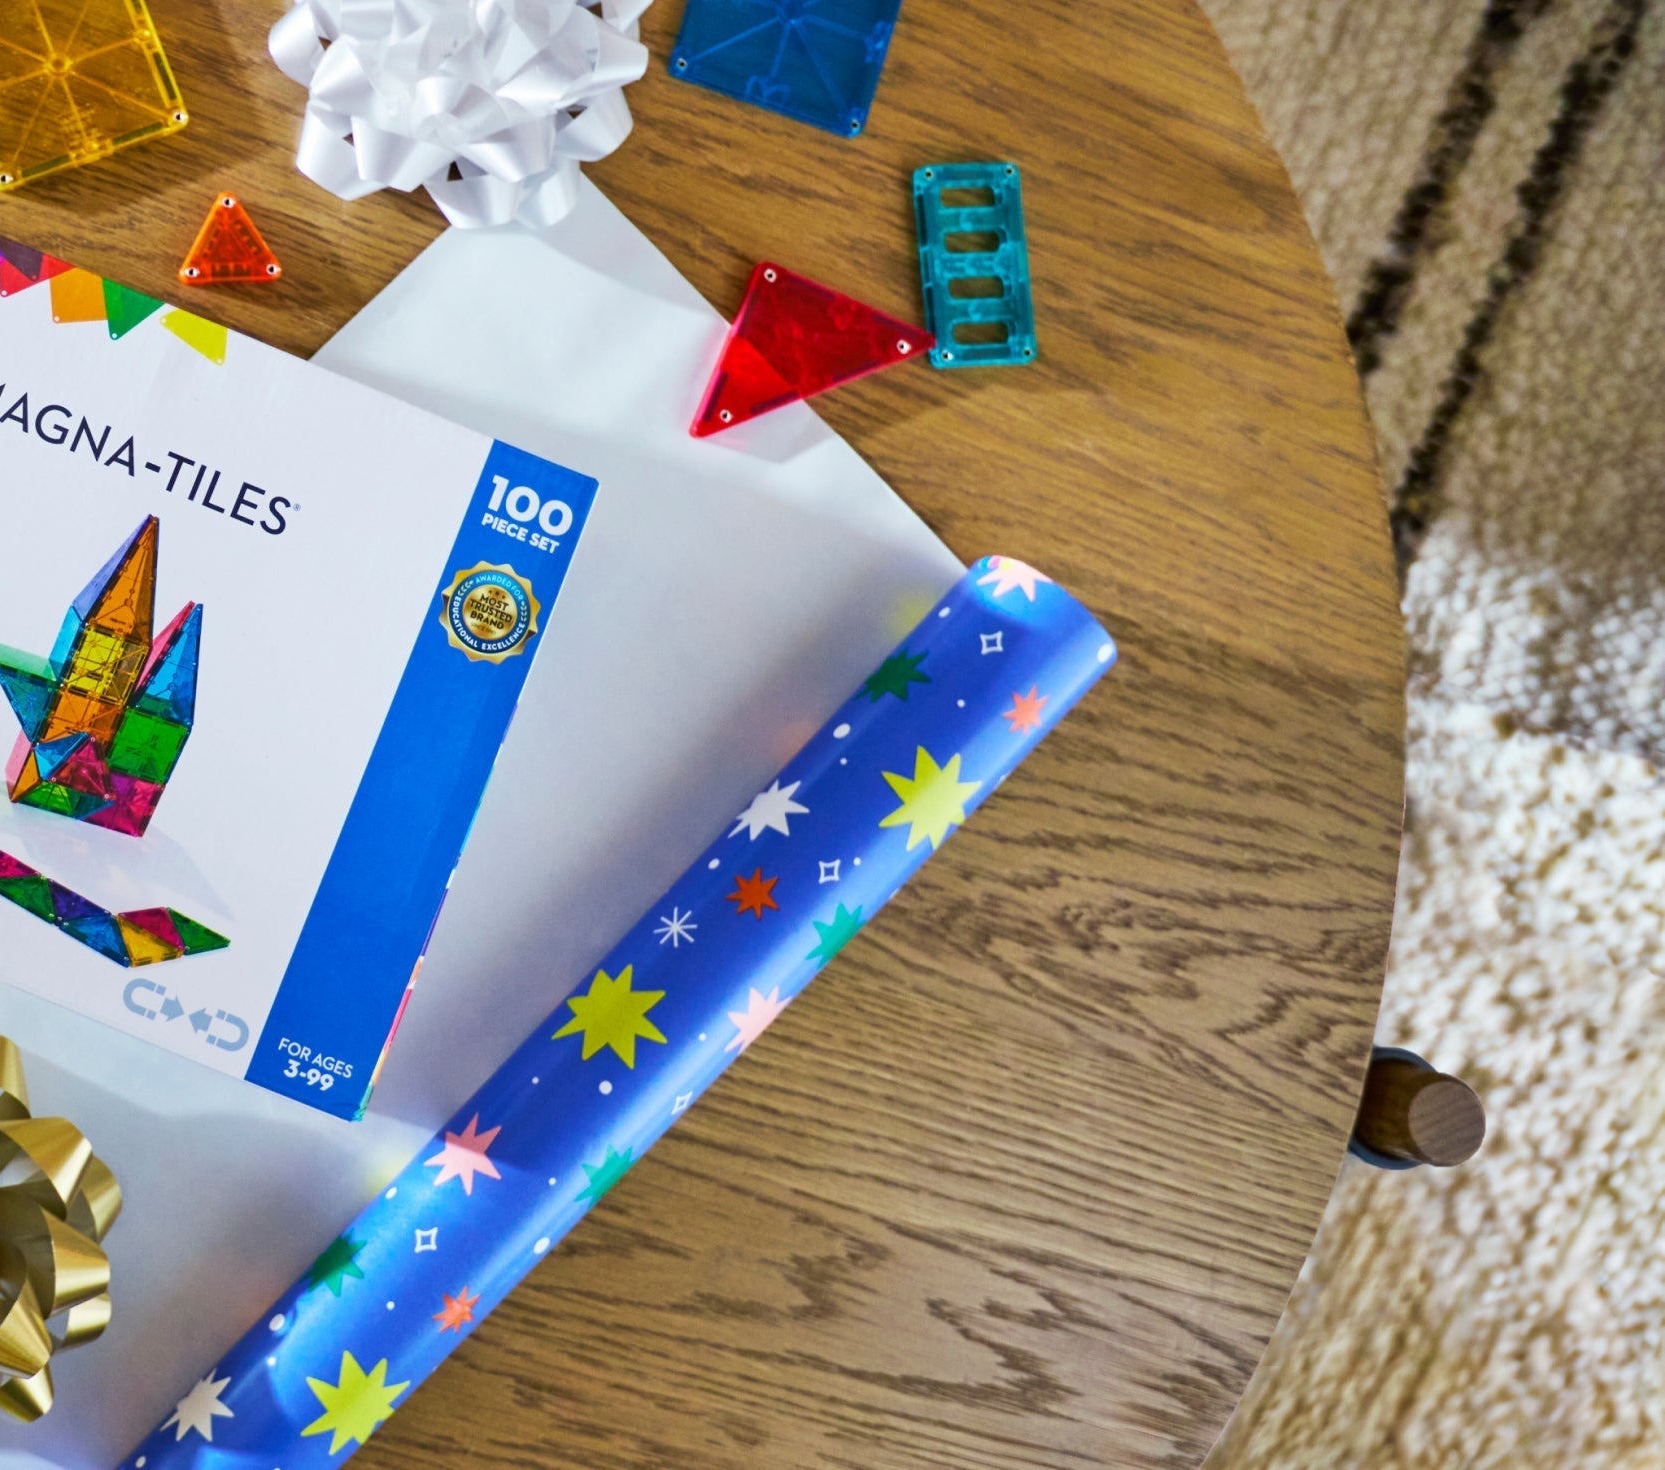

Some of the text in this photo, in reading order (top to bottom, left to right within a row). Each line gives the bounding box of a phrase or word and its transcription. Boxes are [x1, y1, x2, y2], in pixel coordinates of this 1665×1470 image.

[488, 474, 573, 536] 100
[481, 512, 560, 555] PIECE SET
[475, 574, 524, 601] AWARDED FOR
[480, 594, 509, 611] MOST
[452, 596, 526, 651] EDUCATIONAL EXCELLENCE
[470, 598, 513, 624] TRUSTED
[470, 609, 504, 630] BRAND
[278, 1037, 354, 1079] FOR AGES
[283, 1059, 335, 1091] 3-99
